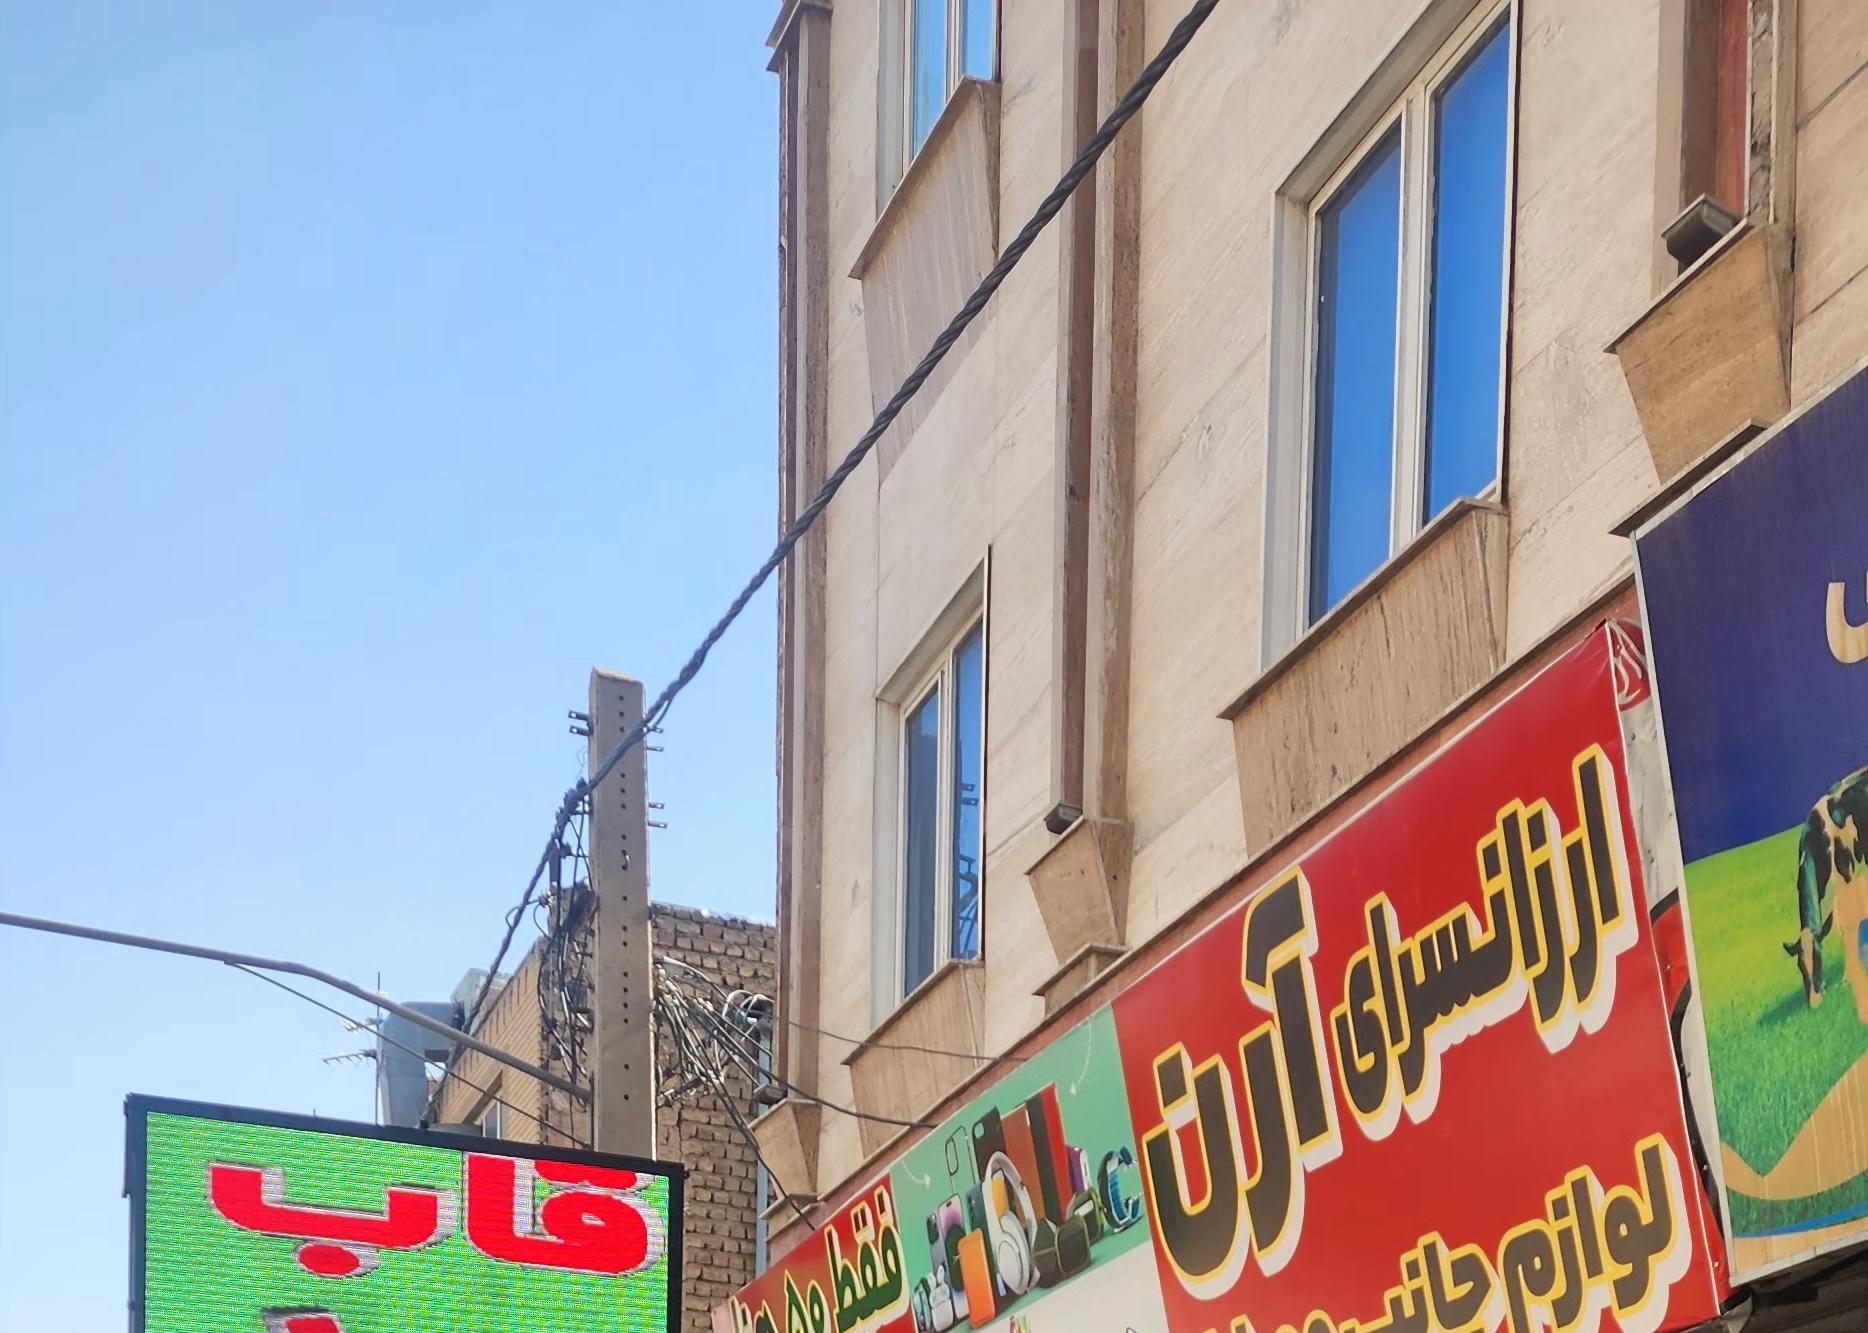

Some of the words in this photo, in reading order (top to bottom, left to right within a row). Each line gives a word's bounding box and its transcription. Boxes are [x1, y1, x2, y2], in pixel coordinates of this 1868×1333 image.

[1142, 866, 1338, 1292] آرن
[1331, 744, 1634, 1130] ارزانسرای
[206, 1152, 664, 1278] قاب
